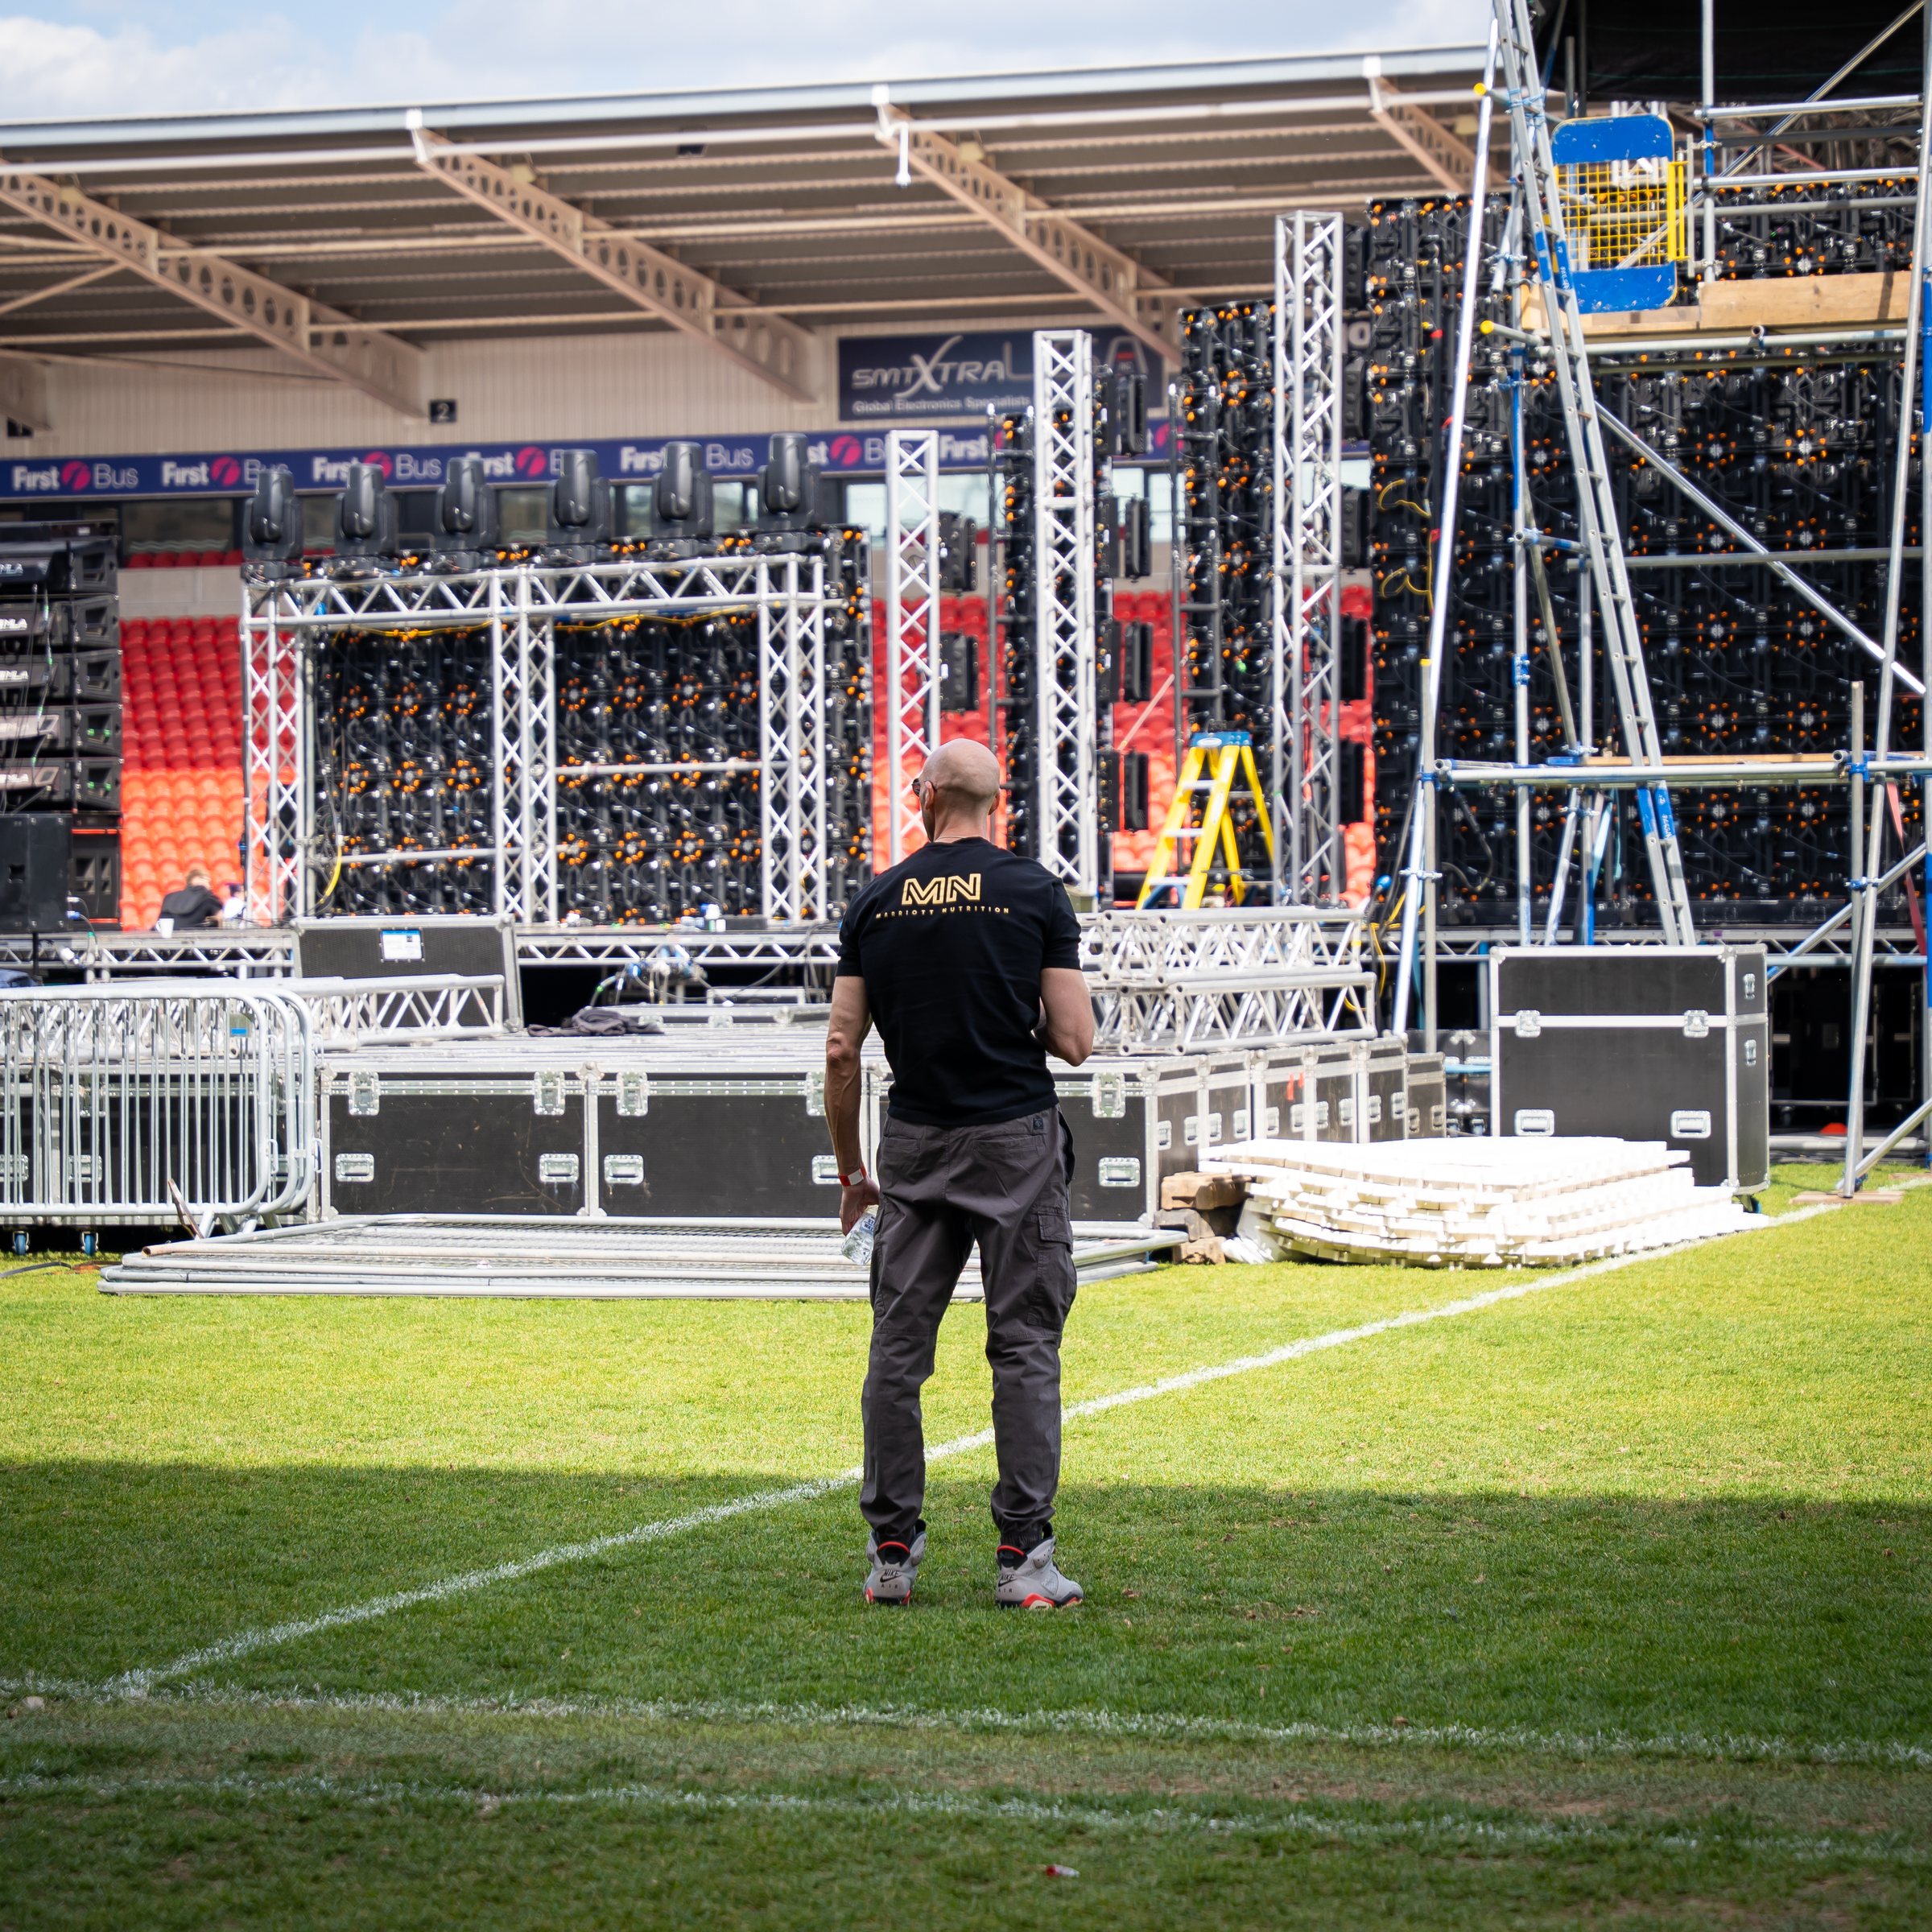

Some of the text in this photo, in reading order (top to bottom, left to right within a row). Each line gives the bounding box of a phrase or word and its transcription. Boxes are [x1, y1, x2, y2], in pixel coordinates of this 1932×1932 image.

[437, 402, 450, 420] 2
[852, 395, 1031, 415] Global Electronics Specialists
[395, 453, 442, 480] Bus
[706, 444, 754, 470] Bus
[12, 463, 139, 491] First Bus
[163, 461, 210, 486] First
[902, 873, 981, 906] MN
[876, 905, 1009, 919] MARRIOTT NUTRITION
[885, 1569, 901, 1578] NIKE
[1001, 1573, 1015, 1581] NIKE
